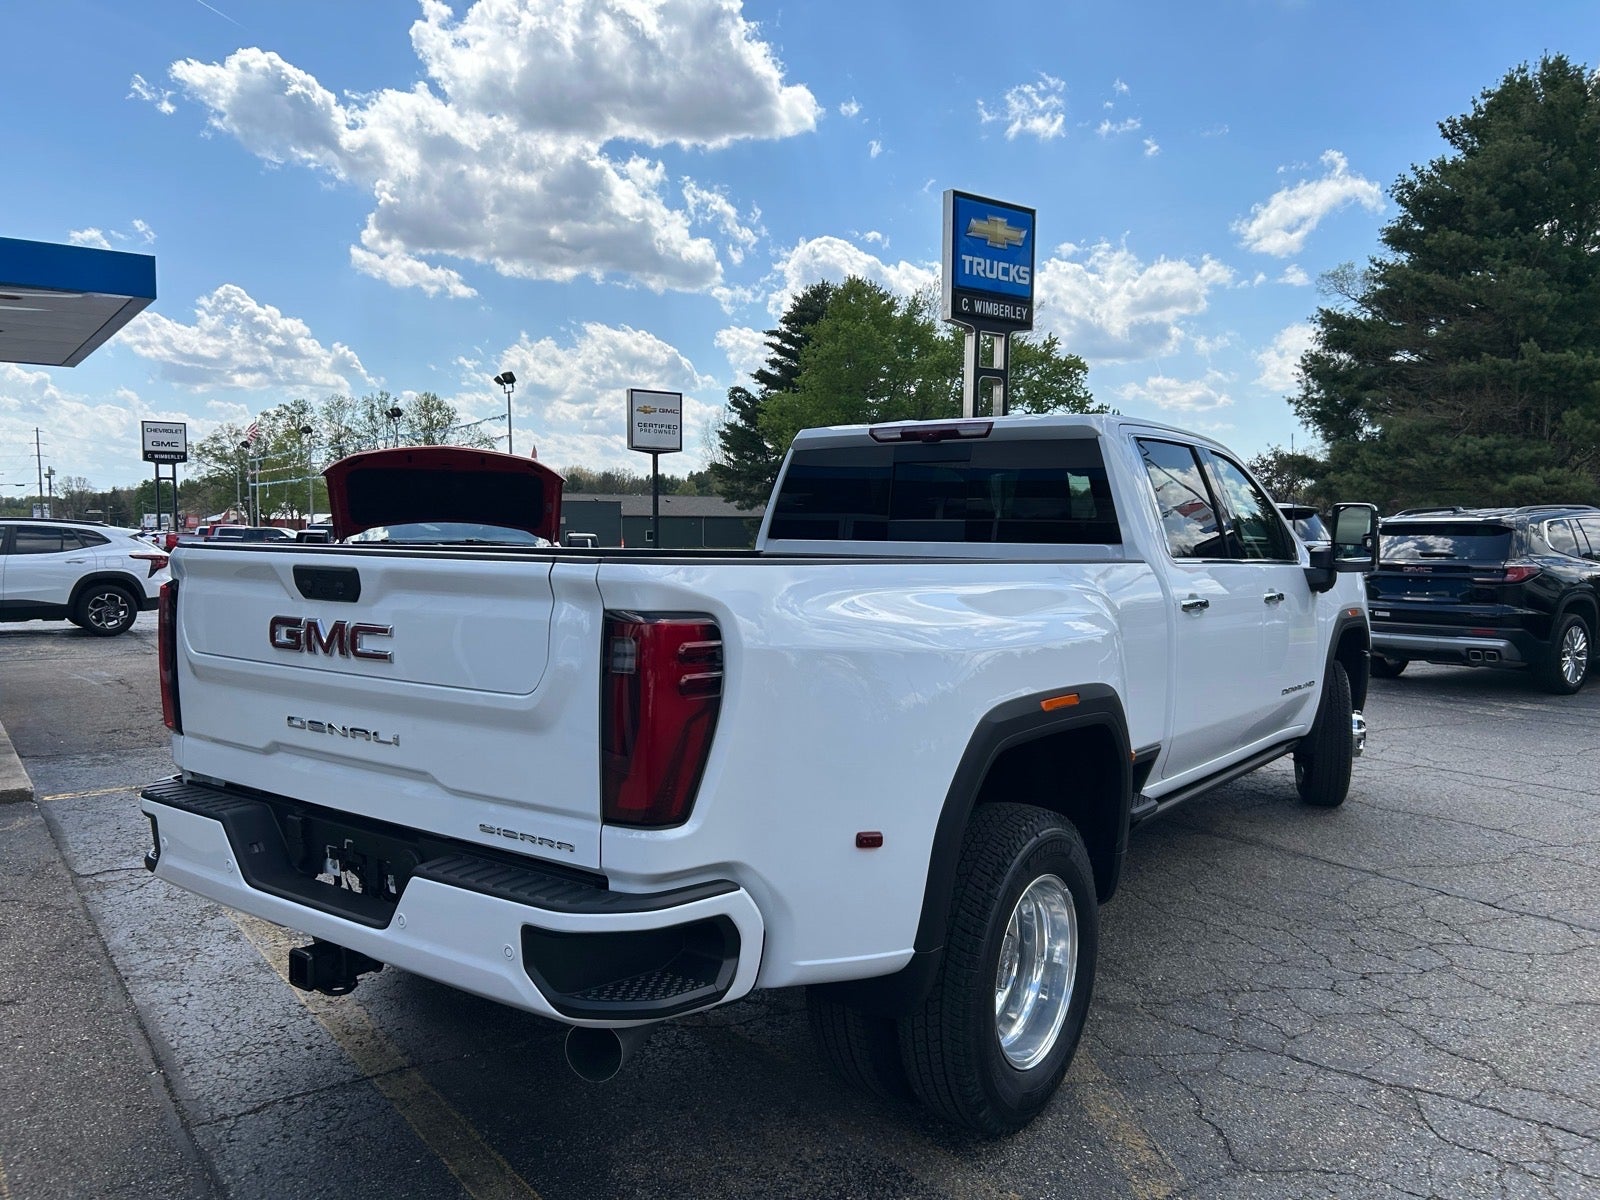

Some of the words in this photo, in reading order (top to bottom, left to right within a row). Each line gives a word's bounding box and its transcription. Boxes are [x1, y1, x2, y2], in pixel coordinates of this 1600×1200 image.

[961, 254, 1030, 285] TRUCKS
[961, 297, 970, 312] C.
[974, 299, 1028, 320] WIMBERLEY
[637, 422, 679, 430] CERTIFIED
[151, 440, 179, 448] GMC
[269, 615, 395, 664] GMC
[286, 715, 400, 747] DENALI
[479, 823, 576, 853] SIERRA
